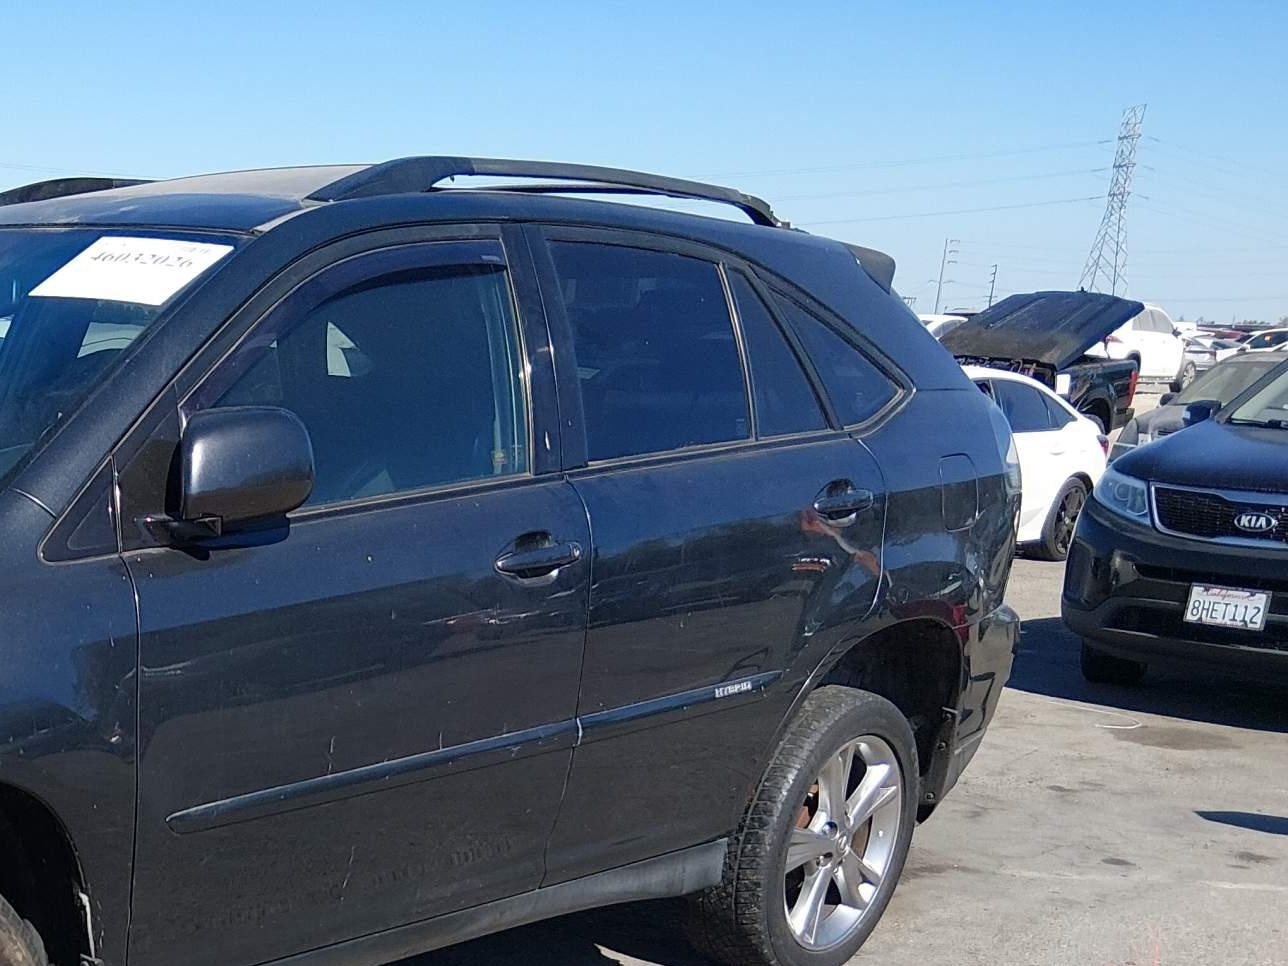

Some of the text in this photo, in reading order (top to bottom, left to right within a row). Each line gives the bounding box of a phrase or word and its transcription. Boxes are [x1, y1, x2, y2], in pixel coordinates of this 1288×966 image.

[91, 251, 193, 268] 46032026
[1240, 515, 1266, 528] KIA
[1191, 599, 1261, 624] 8HET112
